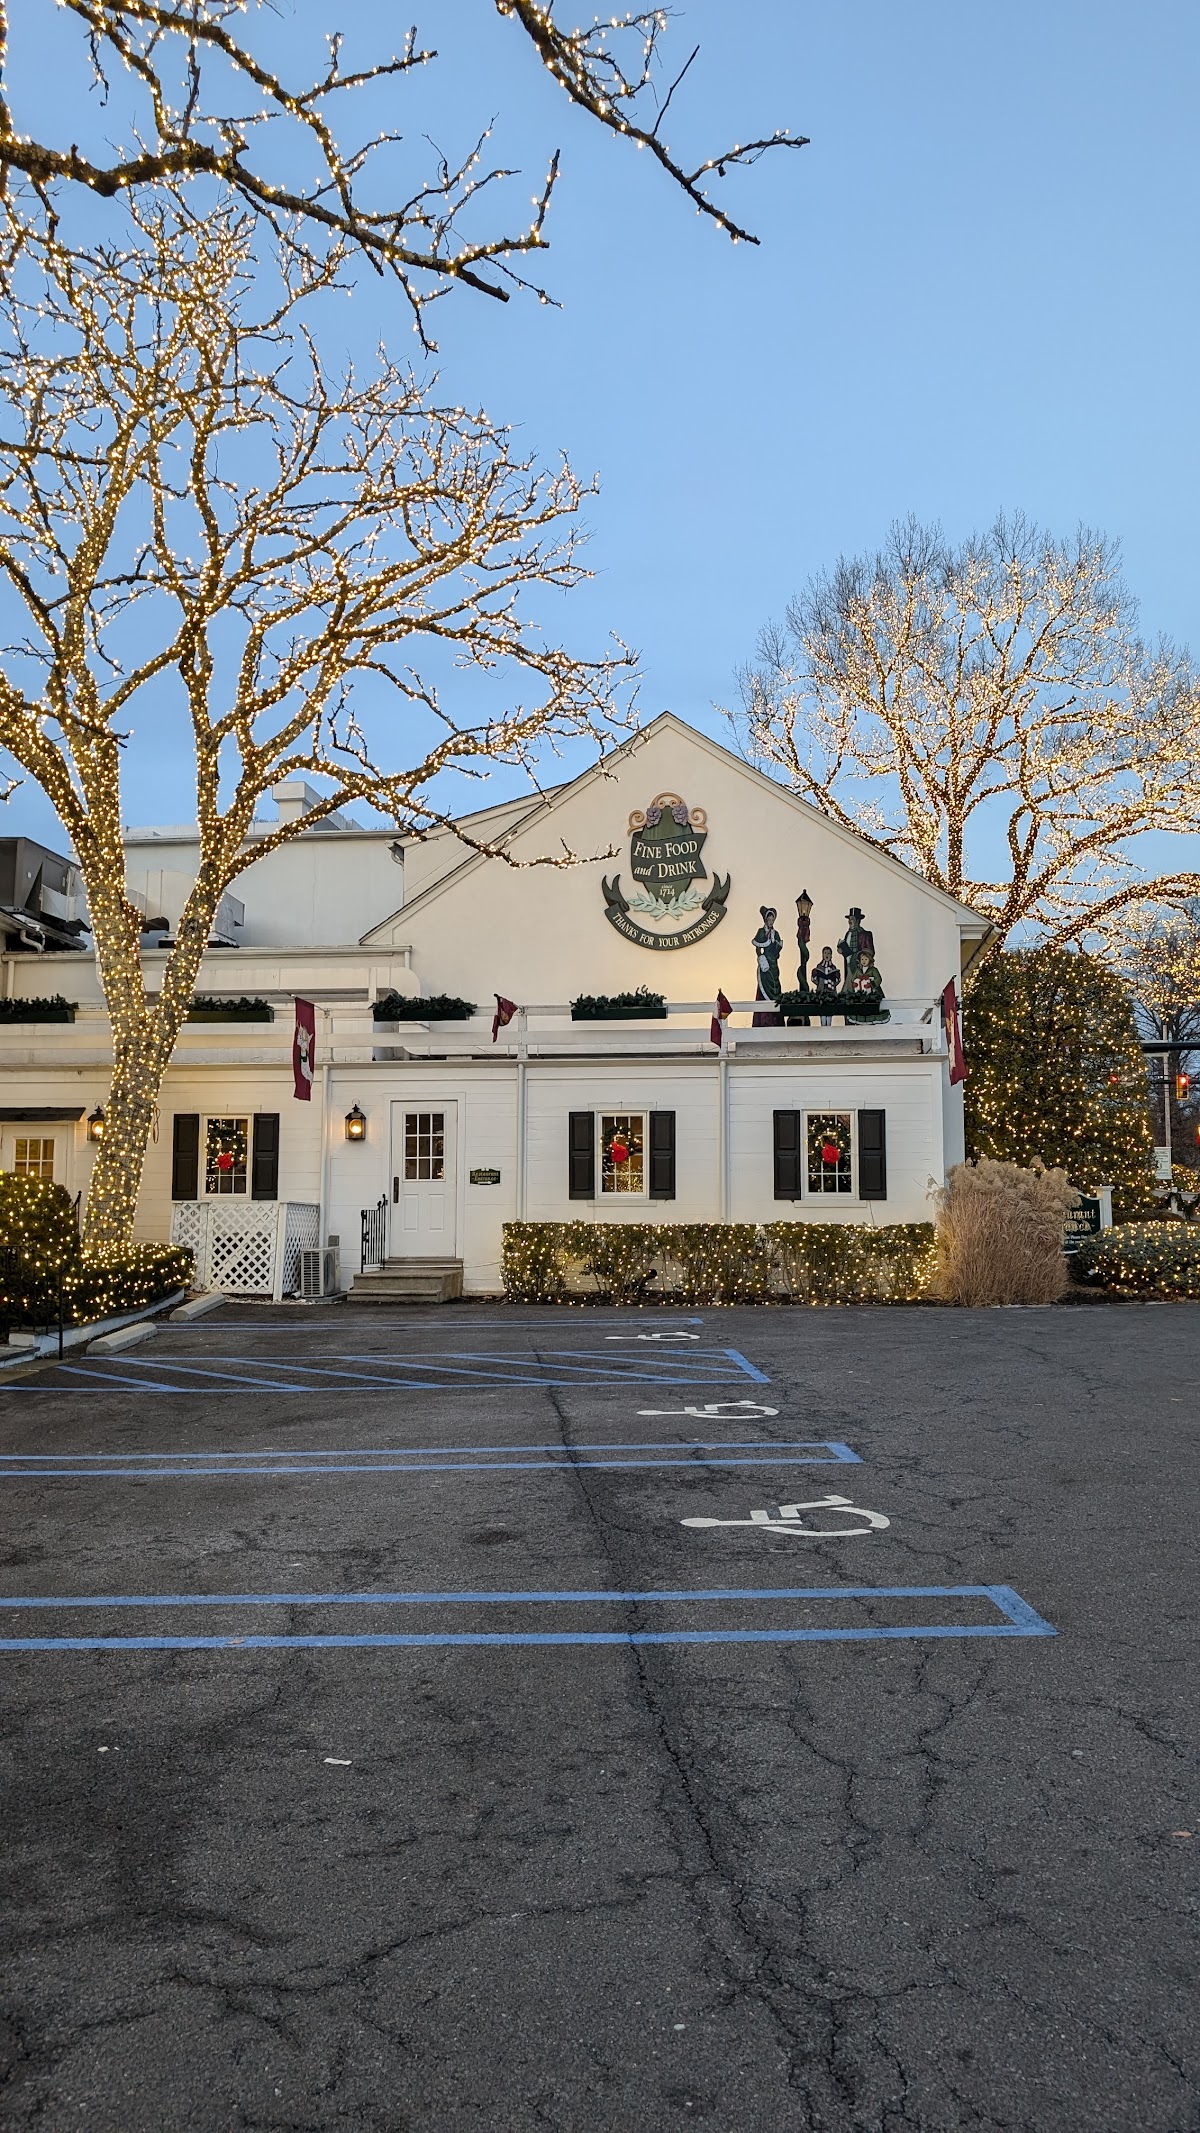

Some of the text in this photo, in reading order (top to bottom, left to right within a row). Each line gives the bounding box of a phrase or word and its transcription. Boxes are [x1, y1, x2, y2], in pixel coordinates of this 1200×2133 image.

[633, 840, 698, 859] FINE FOOD
[634, 860, 697, 878] and DRINK
[659, 888, 675, 897] 1714
[612, 910, 720, 948] THANKS FOR YOUR PATRONAGE
